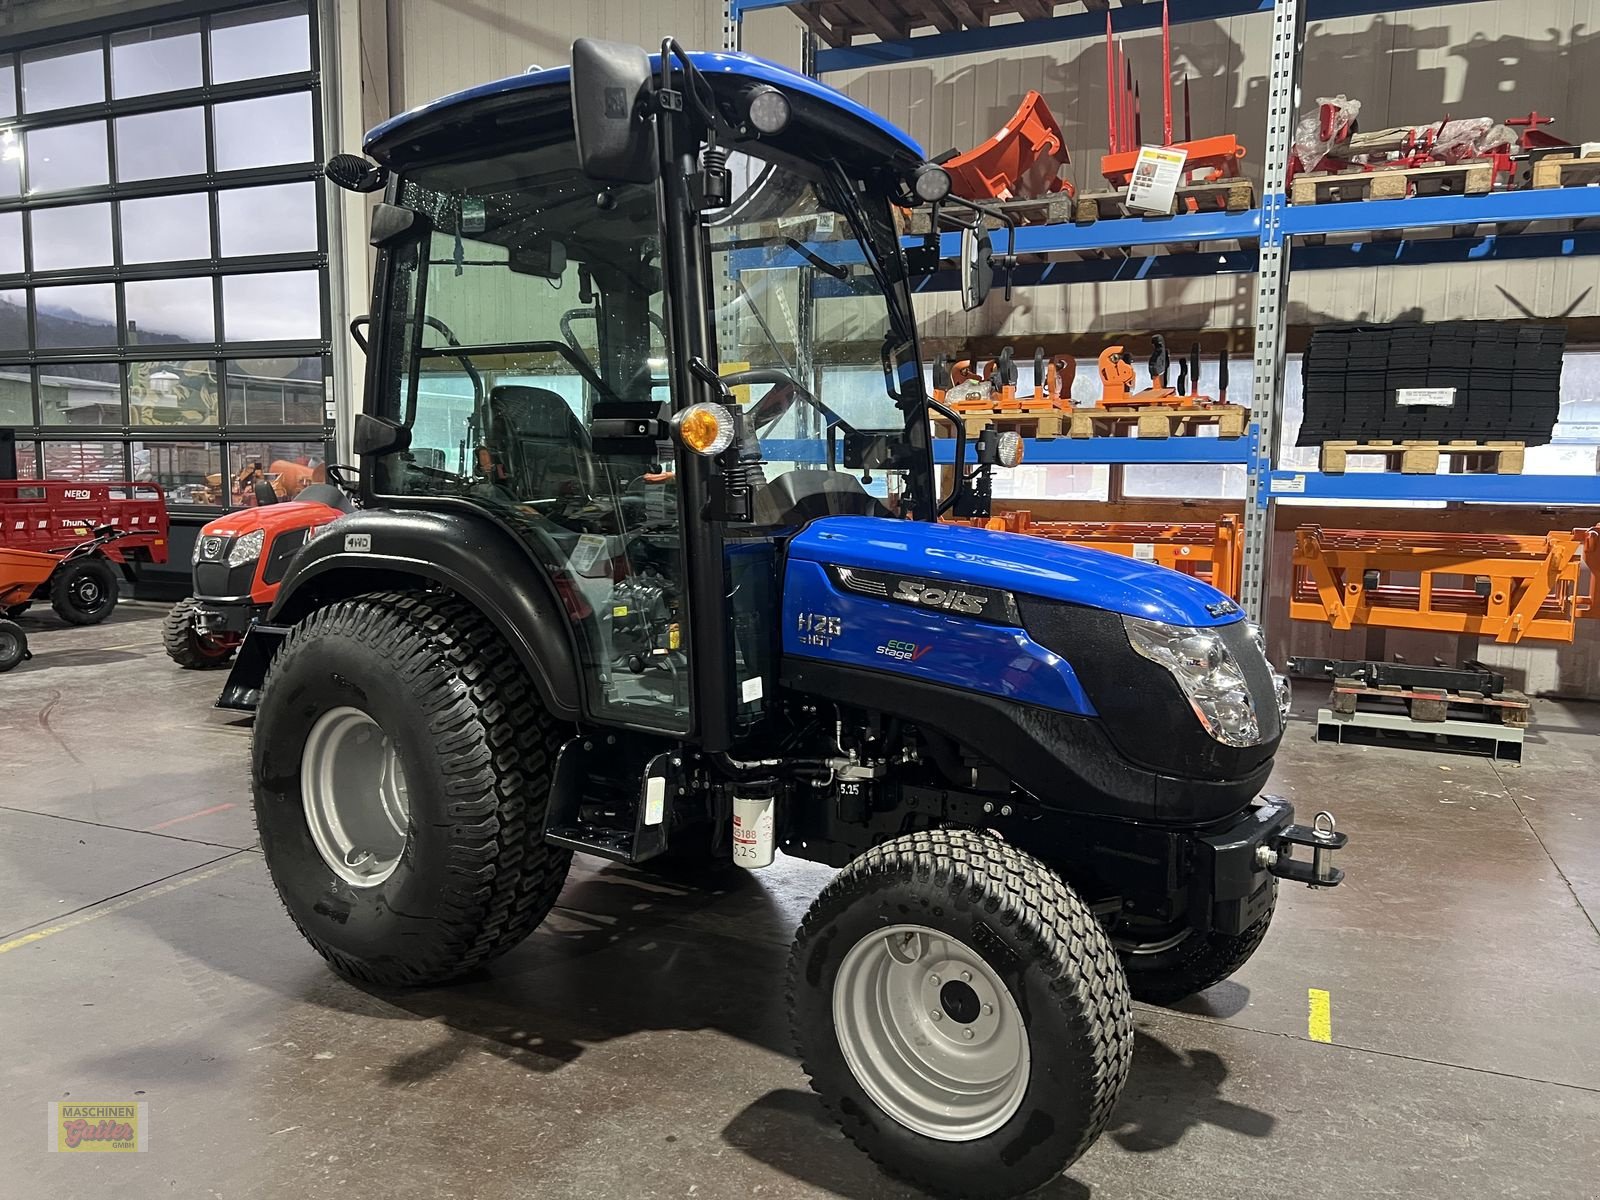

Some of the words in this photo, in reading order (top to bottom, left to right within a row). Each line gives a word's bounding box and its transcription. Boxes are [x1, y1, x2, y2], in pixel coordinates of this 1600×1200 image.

[64, 490, 91, 499] NERO
[348, 537, 368, 548] 4WD
[840, 783, 860, 796] 5.25
